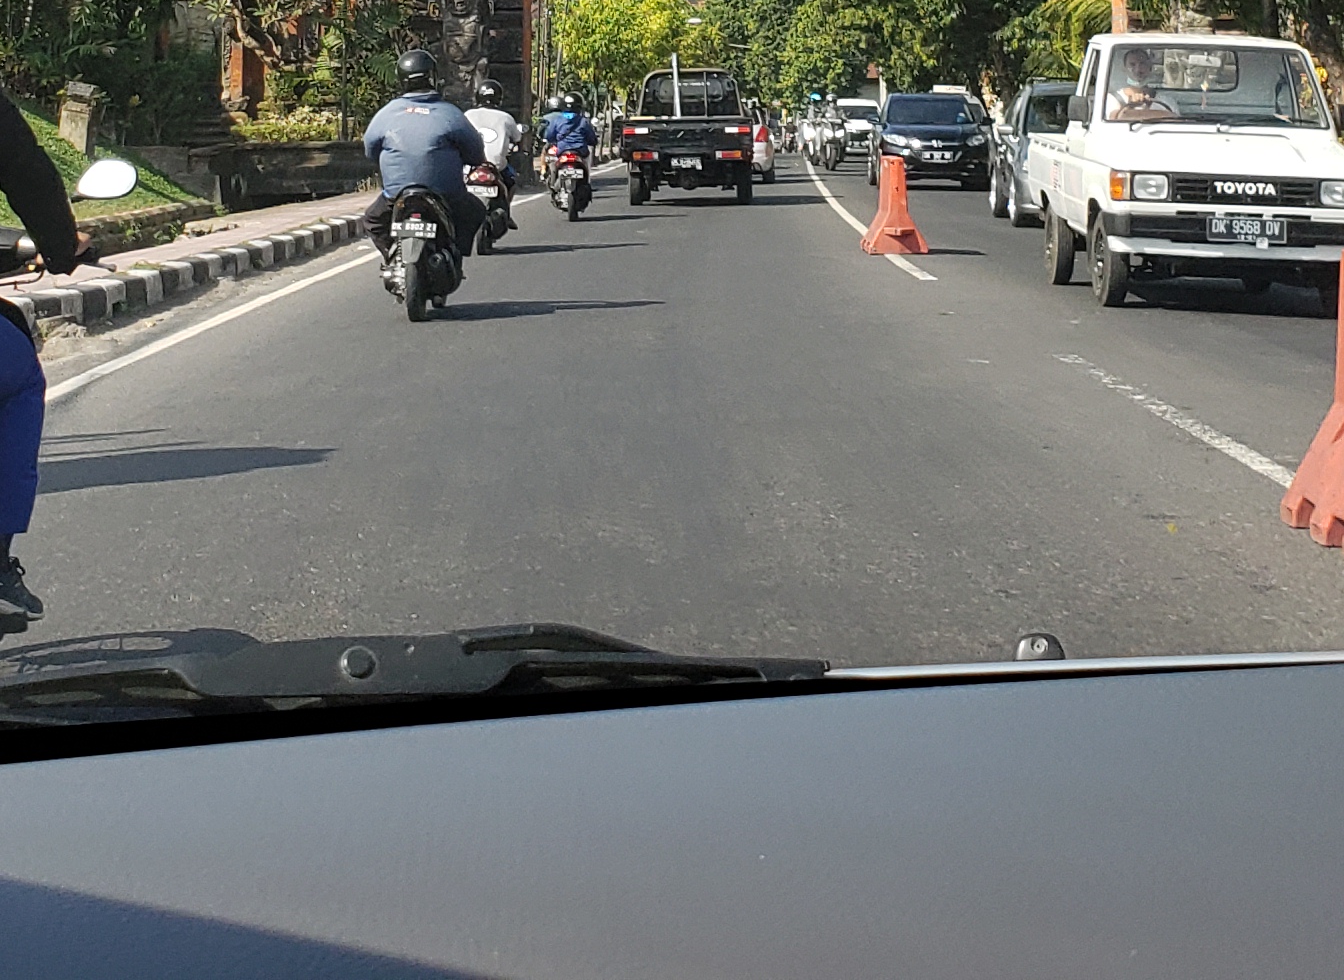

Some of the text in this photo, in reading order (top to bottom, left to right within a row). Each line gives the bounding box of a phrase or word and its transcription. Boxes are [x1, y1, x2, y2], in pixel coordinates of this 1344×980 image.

[1213, 180, 1277, 196] TOYOTA
[1211, 219, 1281, 236] DK 9568 DV
